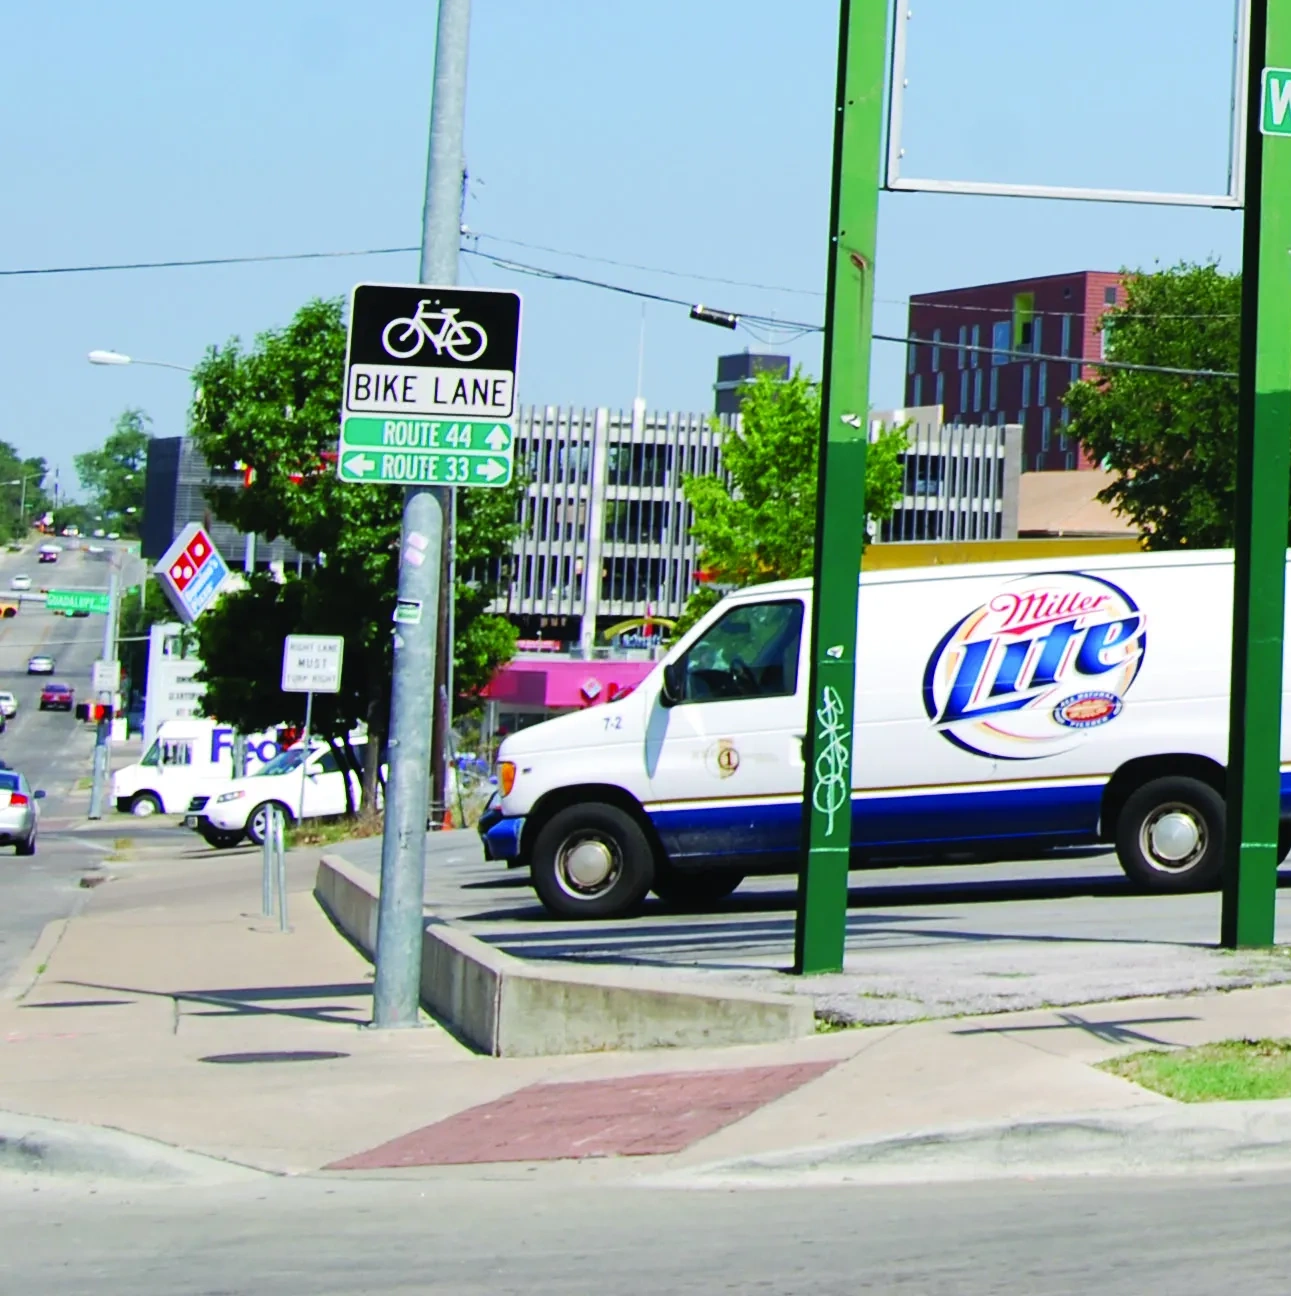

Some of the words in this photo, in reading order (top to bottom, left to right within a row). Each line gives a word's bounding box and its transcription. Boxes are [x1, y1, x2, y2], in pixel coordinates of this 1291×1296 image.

[355, 373, 417, 403] BIKE
[433, 376, 506, 406] LANE
[382, 421, 440, 447] ROUTE
[445, 424, 472, 448] 44
[381, 454, 439, 480] ROUTE
[445, 456, 469, 481] 33
[990, 592, 1111, 628] Miller
[289, 643, 314, 652] RIGHT
[317, 644, 338, 653] LANE
[298, 658, 327, 670] MUST
[933, 614, 1143, 727] Lite
[311, 675, 337, 684] RIGHT
[604, 717, 622, 730] 7-2
